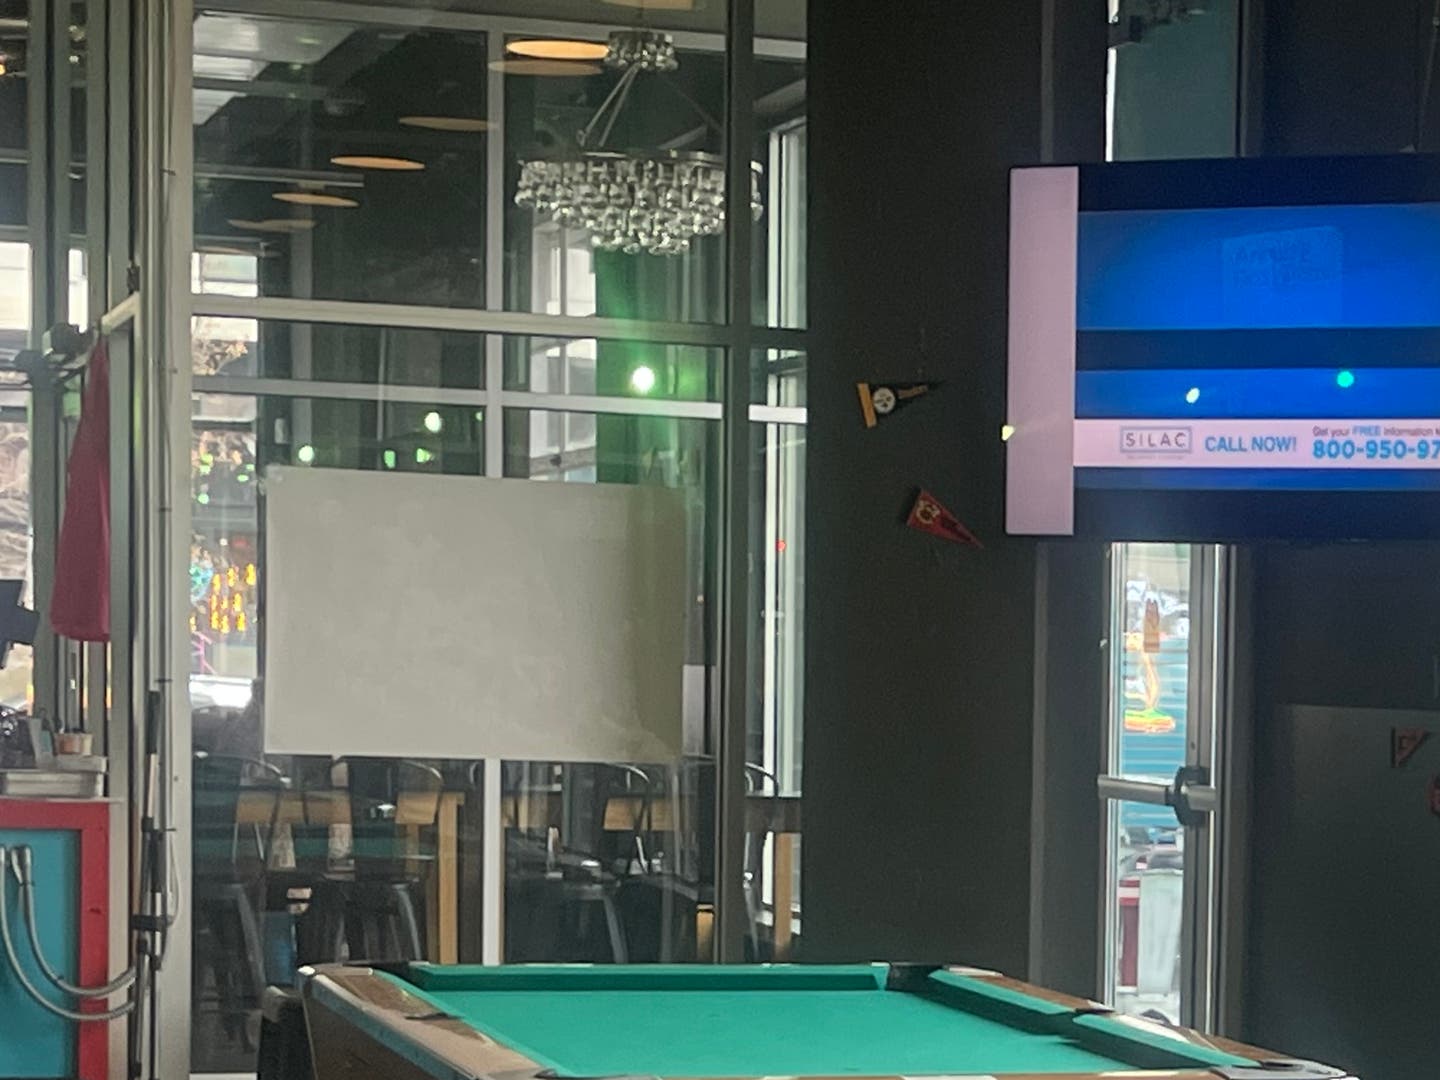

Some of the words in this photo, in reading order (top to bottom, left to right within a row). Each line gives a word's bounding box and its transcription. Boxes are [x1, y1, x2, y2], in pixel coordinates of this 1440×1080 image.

[1352, 425, 1381, 436] FREE
[1125, 432, 1186, 448] SILAC
[1204, 436, 1248, 452] CALL
[1251, 436, 1297, 452] NOW!
